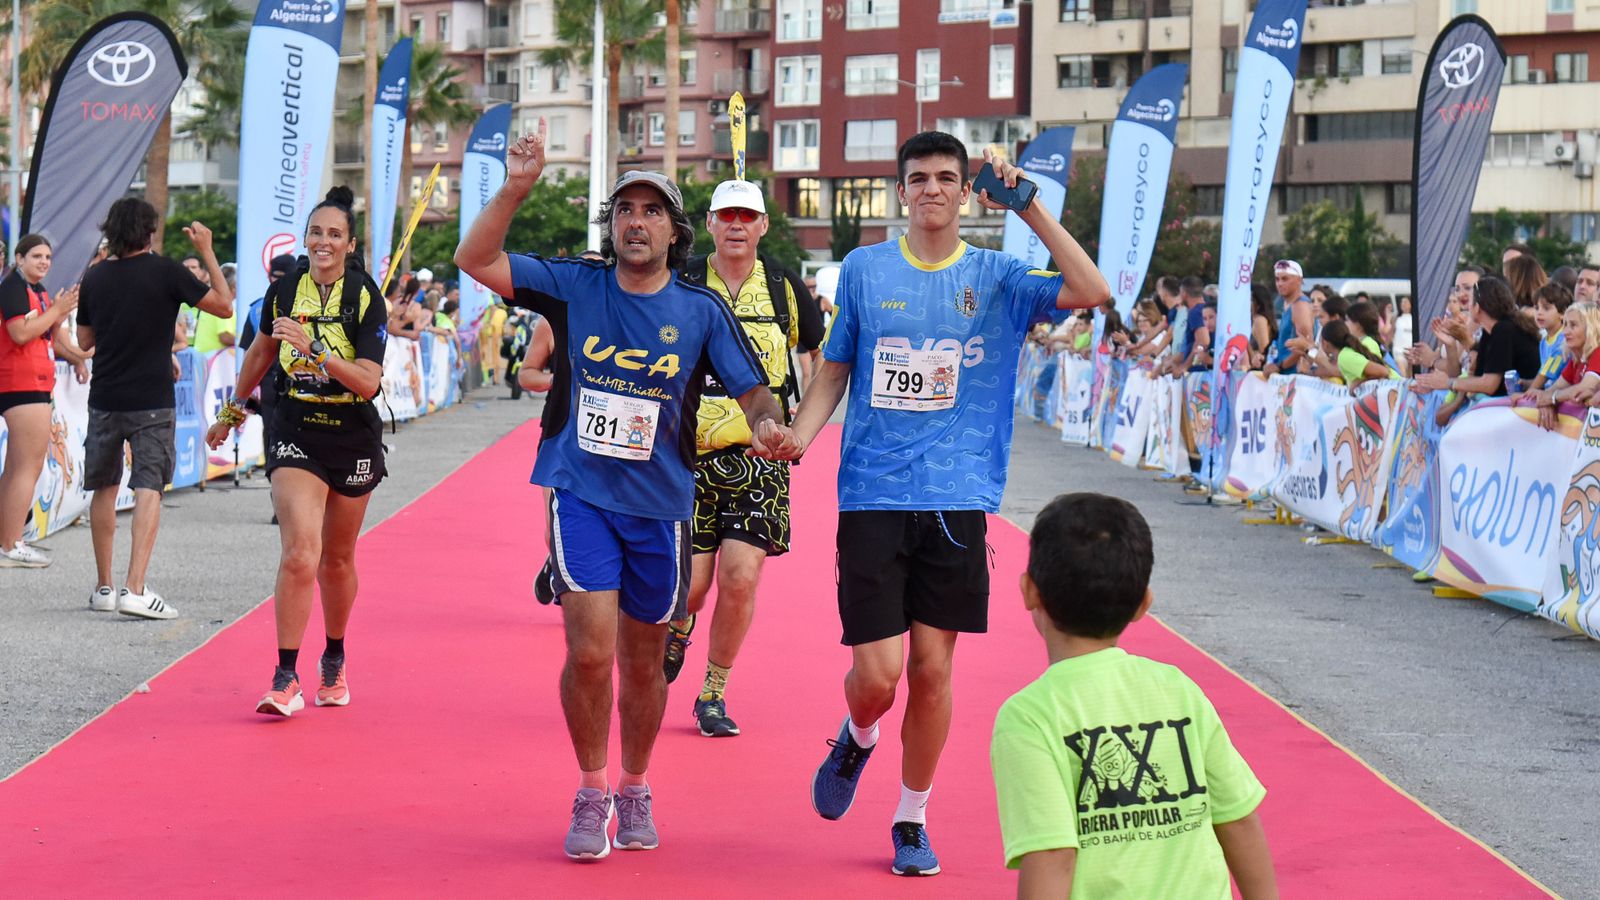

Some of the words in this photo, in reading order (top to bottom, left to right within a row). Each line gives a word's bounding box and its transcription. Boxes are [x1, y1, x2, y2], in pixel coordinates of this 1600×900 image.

[270, 8, 322, 23] Algeciras
[81, 101, 158, 121] TOMAX
[272, 43, 304, 225] lalíneavertical
[1243, 79, 1273, 249] Sergeyco
[1127, 142, 1150, 265] Sergeyco
[881, 298, 907, 311] vive
[582, 335, 681, 379] UCA
[878, 351, 893, 362] XXI
[885, 369, 923, 394] 799
[582, 393, 594, 405] XXI
[303, 415, 342, 426] HANKER
[585, 412, 618, 439] 781
[1450, 447, 1556, 559] exolum
[1063, 716, 1207, 813] XXI
[1122, 806, 1182, 829] POPULAR
[1139, 831, 1153, 841] DE
